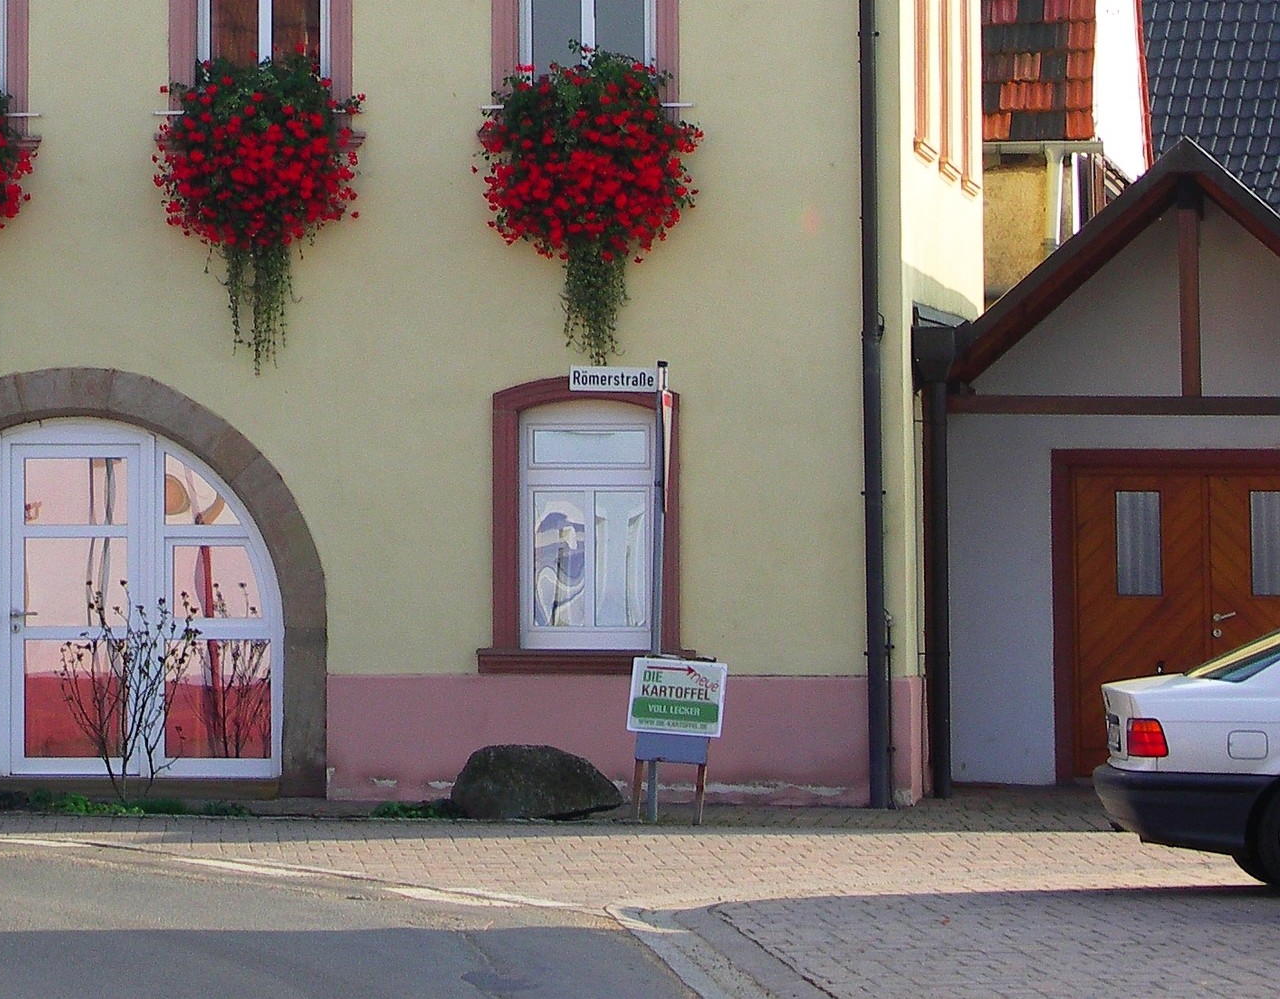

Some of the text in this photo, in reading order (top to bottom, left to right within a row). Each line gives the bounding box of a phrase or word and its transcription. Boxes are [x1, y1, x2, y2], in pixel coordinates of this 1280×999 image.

[572, 370, 654, 387] Römerstraße
[643, 670, 663, 682] DIE
[690, 672, 719, 692] neue
[641, 684, 710, 700] KARTOFFEL
[648, 704, 700, 716] VOLL LECKER
